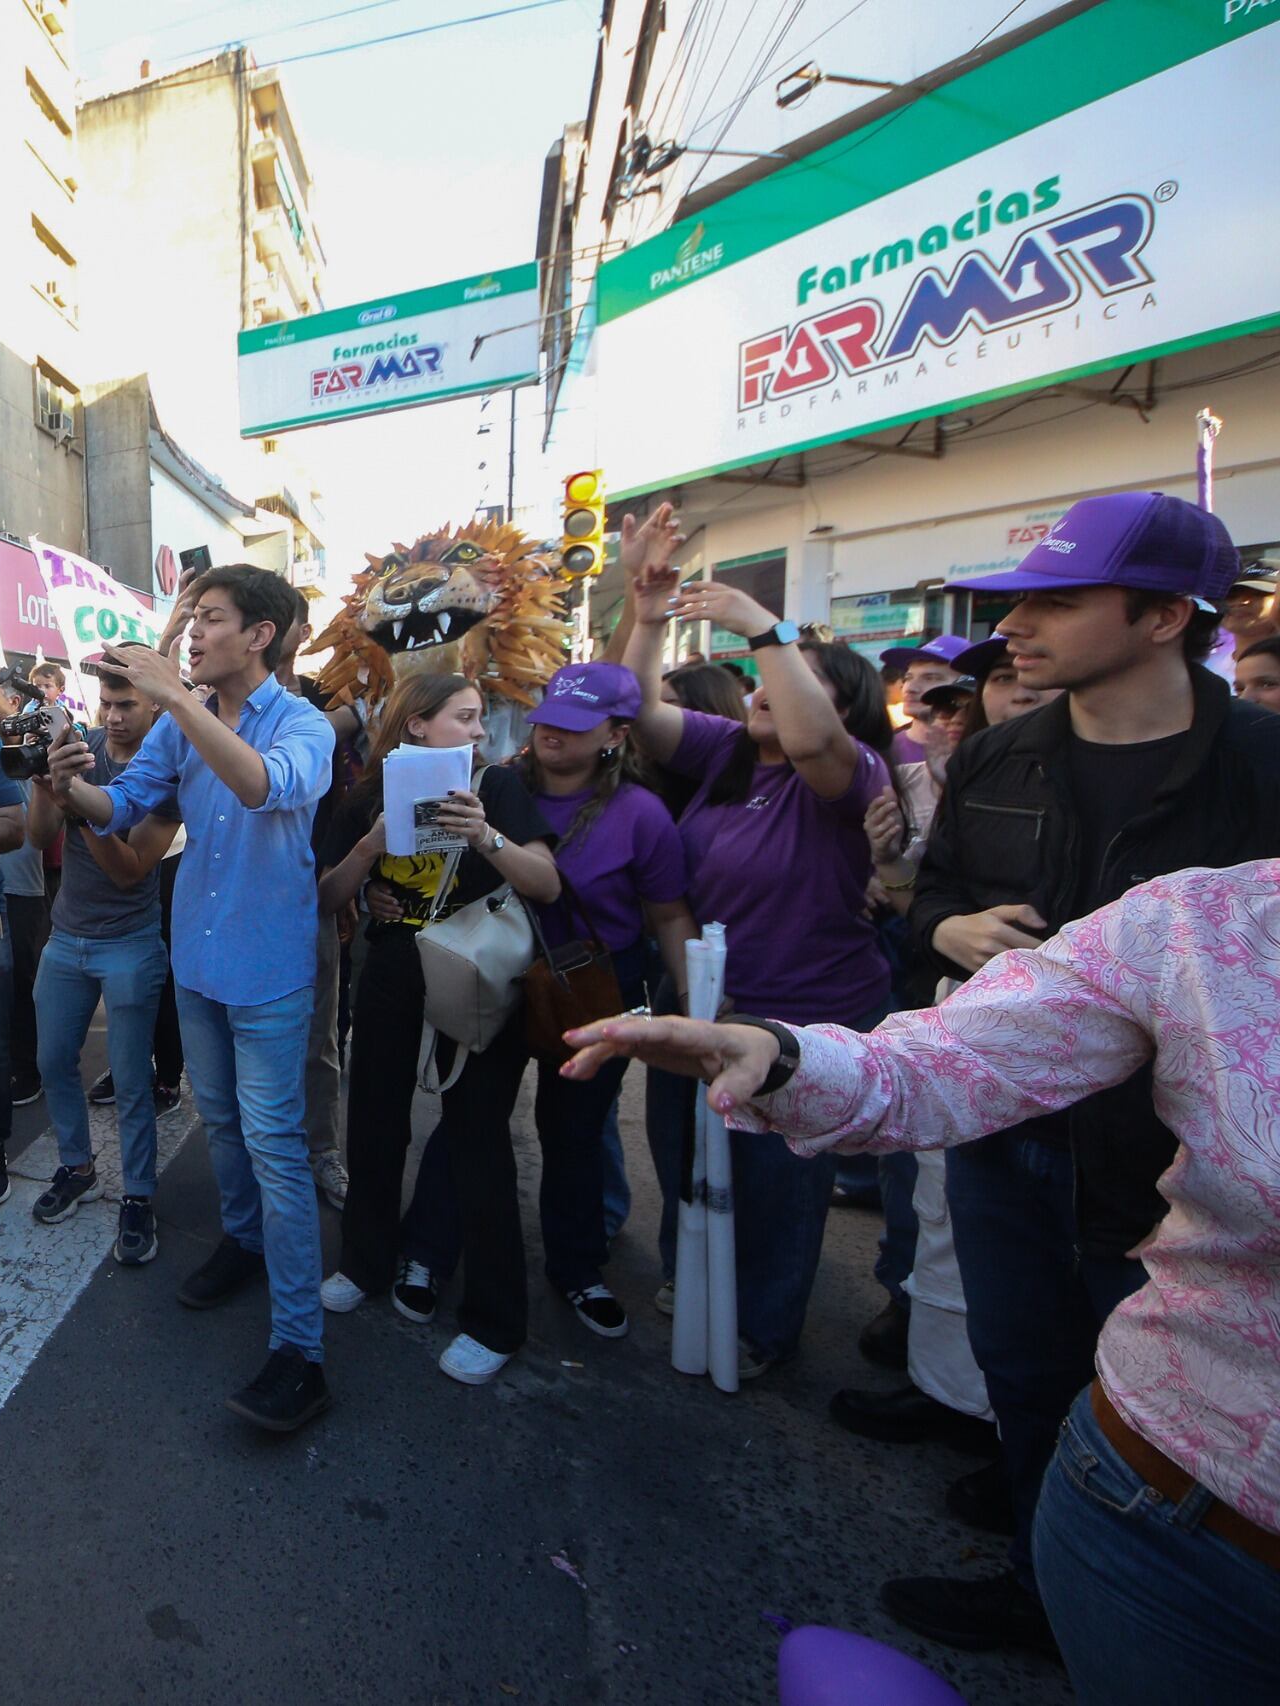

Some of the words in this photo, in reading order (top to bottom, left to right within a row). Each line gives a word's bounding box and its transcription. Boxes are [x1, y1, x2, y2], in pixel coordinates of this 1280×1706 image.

[650, 243, 724, 291] PANTENE
[797, 174, 1061, 305] Farmacias
[333, 333, 418, 361] Farmacias
[738, 193, 1155, 411] FARMAR
[310, 345, 444, 399] FARMAR
[738, 403, 791, 430] RED
[808, 292, 1158, 410] FARMACÉUTICA
